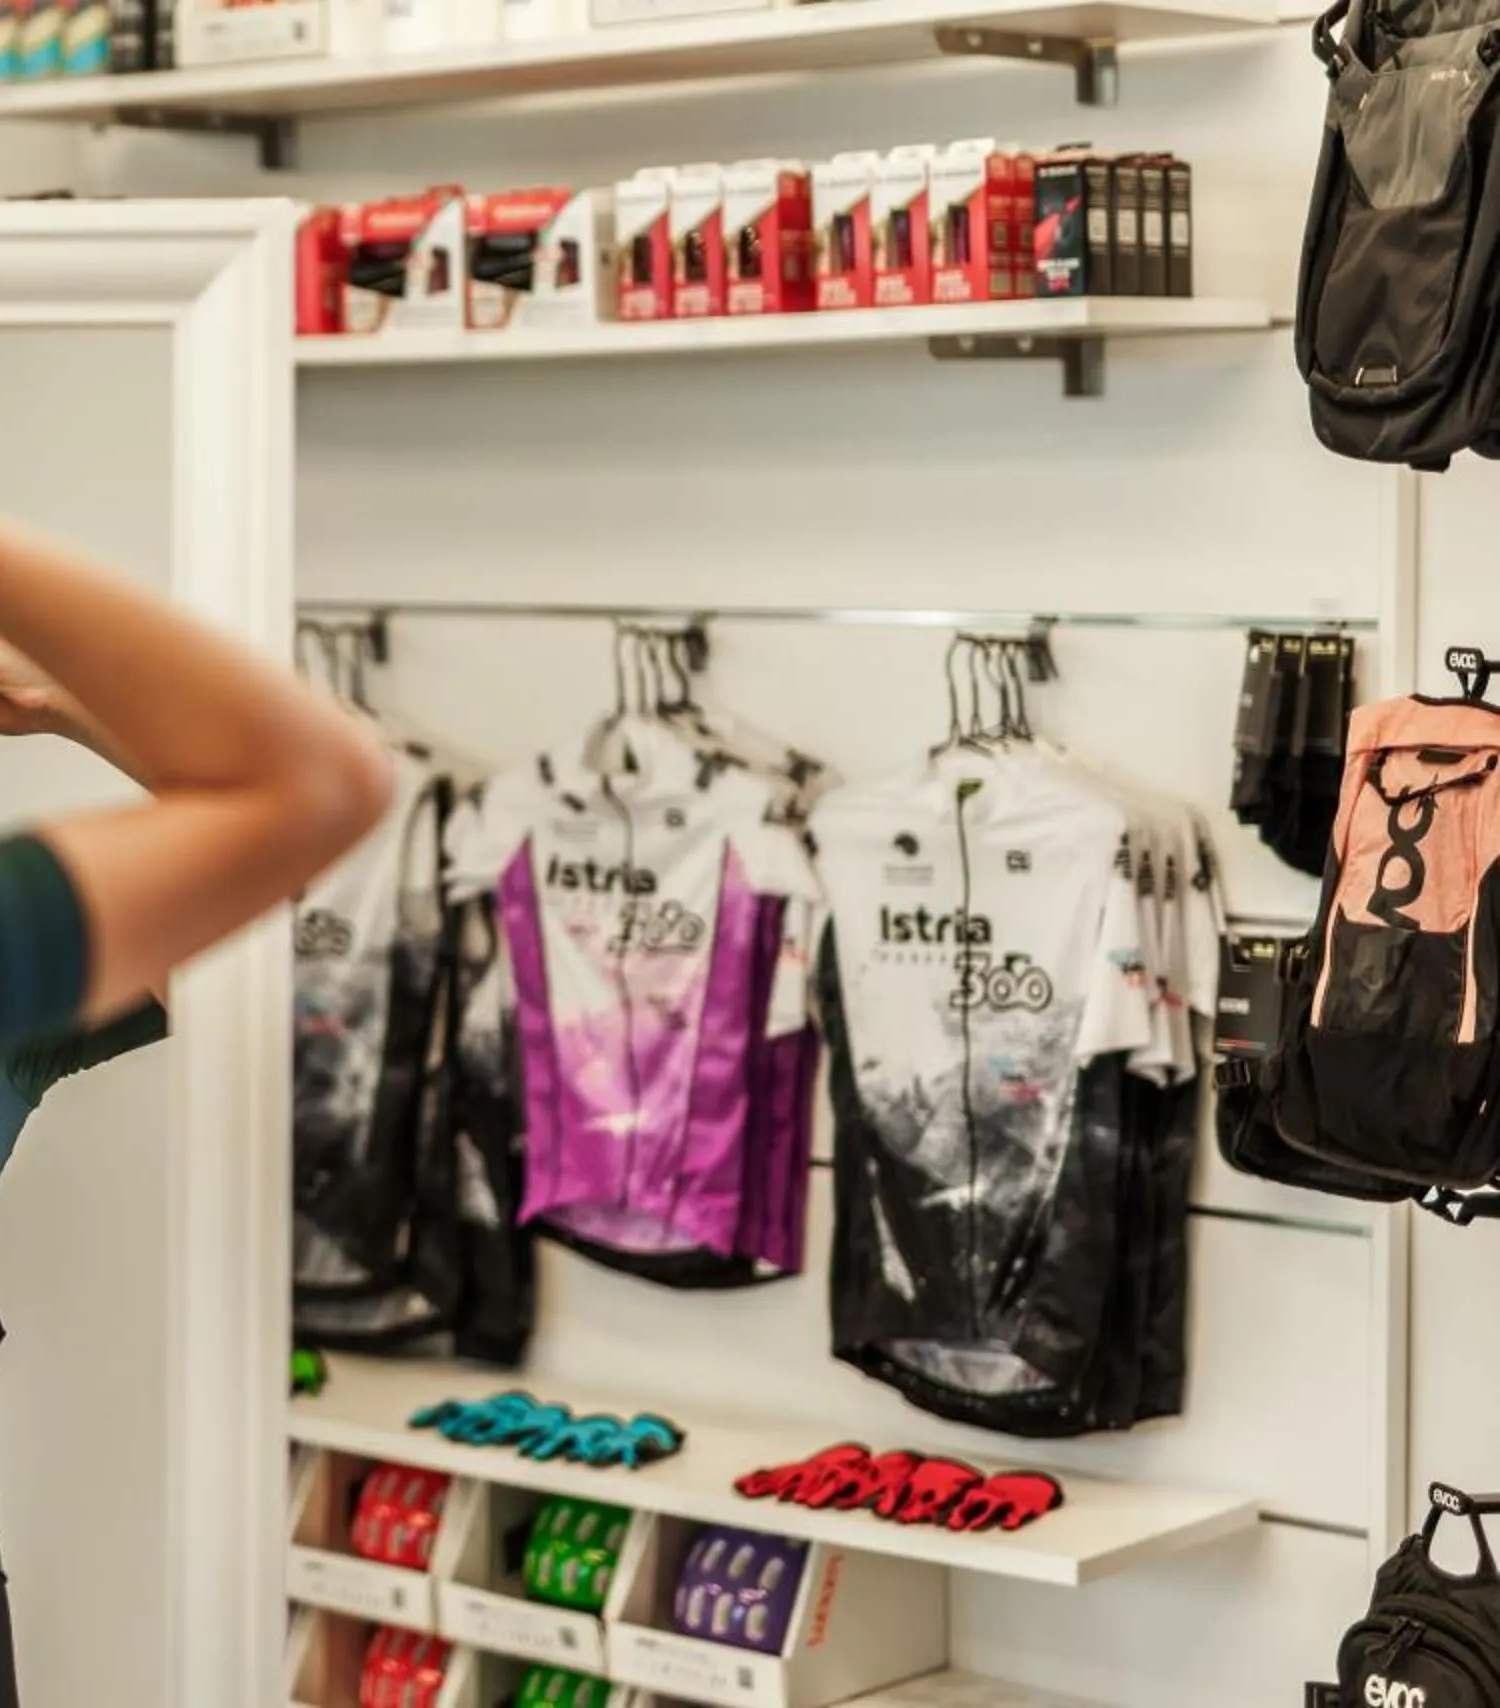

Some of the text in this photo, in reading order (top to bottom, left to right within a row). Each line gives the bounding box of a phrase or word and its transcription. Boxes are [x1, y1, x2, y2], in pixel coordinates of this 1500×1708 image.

[547, 855, 658, 894] Istria
[880, 904, 991, 943] Istria
[949, 950, 1053, 1013] 300
